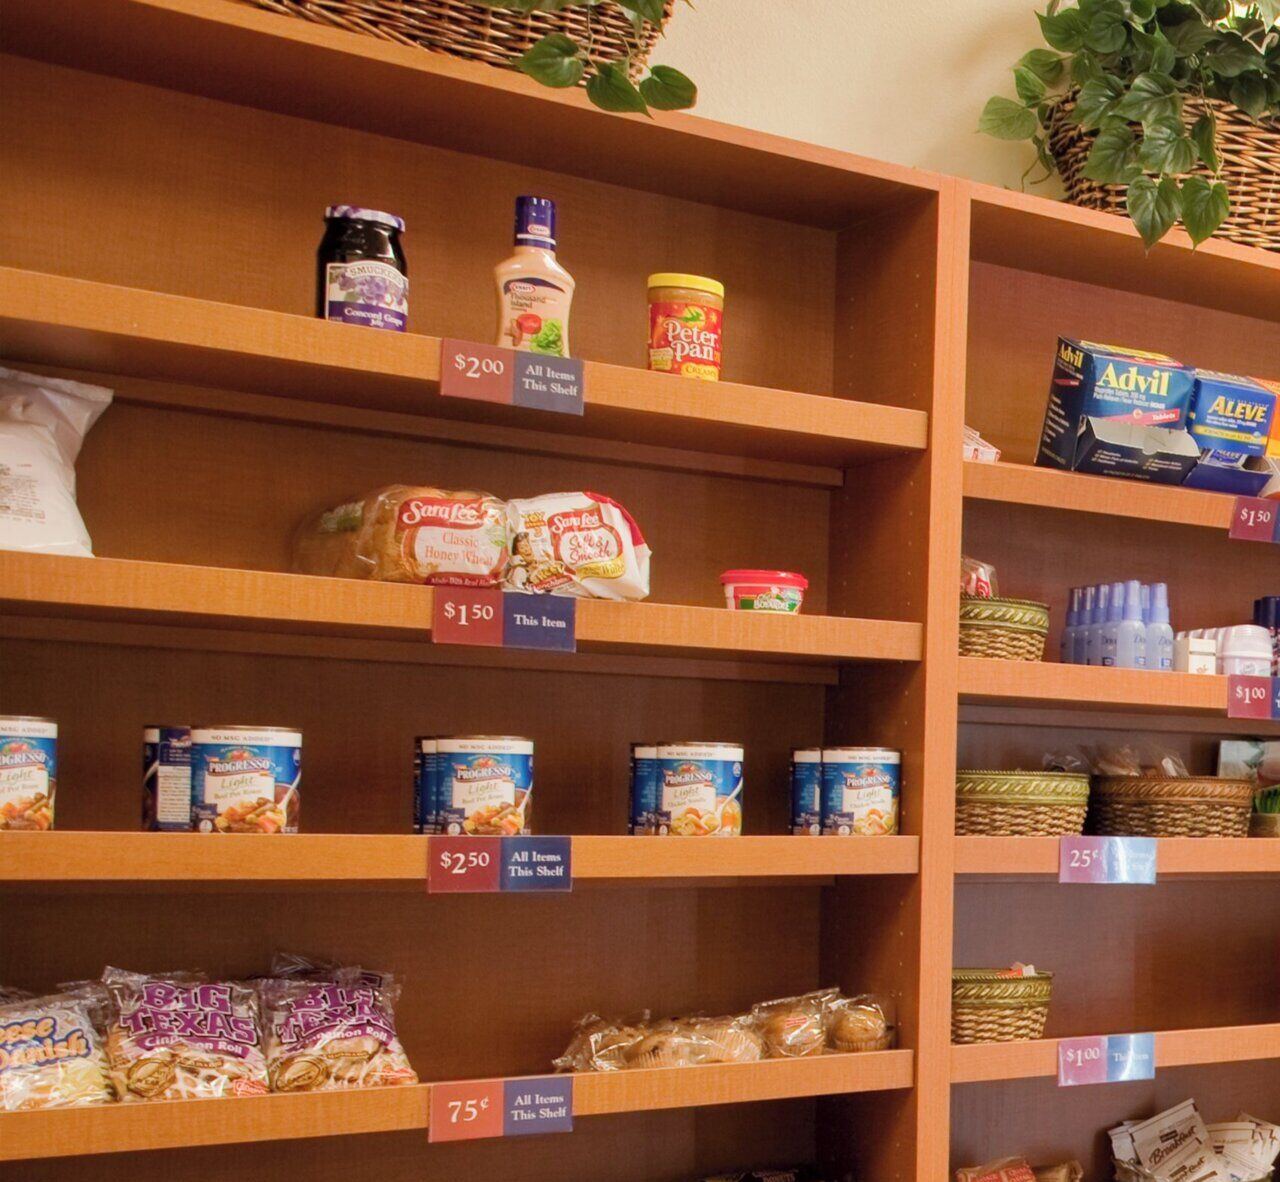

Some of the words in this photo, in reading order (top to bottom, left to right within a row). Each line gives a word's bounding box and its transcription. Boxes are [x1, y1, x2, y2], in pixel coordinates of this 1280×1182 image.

[344, 306, 382, 324] Concord
[664, 318, 718, 348] Peter
[671, 340, 715, 362] Pan
[1059, 342, 1083, 369] Advil
[525, 364, 543, 376] All
[546, 366, 575, 382] Items
[1097, 362, 1172, 397] Advil
[522, 378, 547, 393] This
[549, 381, 578, 397] Shelf
[1209, 395, 1267, 422] ALEVE
[401, 501, 450, 524] Sara
[447, 500, 481, 525] Lee
[550, 514, 582, 533] Sara
[442, 532, 479, 549] Classic
[425, 545, 460, 562] Honey
[463, 550, 494, 567] Wheat
[513, 614, 540, 627] This
[544, 615, 567, 629] Item
[209, 758, 271, 773] PROGRESSO
[457, 765, 511, 780] PROGRESSO
[221, 776, 254, 790] Light
[665, 769, 712, 785] PROGRESSO
[847, 774, 893, 788] PROGRESSO
[468, 781, 499, 796] Light
[673, 786, 700, 800] Light
[511, 850, 529, 864] All
[531, 852, 562, 865] Items
[1069, 849, 1099, 868] 25¢
[508, 865, 533, 878] This
[535, 866, 565, 879] Shelf
[142, 982, 233, 1016] BIG
[121, 1010, 258, 1045] TEXAS
[365, 1025, 387, 1041] Roll
[217, 1040, 243, 1053] Roll
[514, 1093, 532, 1106] All
[534, 1092, 565, 1106] Items
[448, 1096, 490, 1124] 75¢
[511, 1107, 538, 1121] This
[539, 1106, 568, 1120] Shelf
